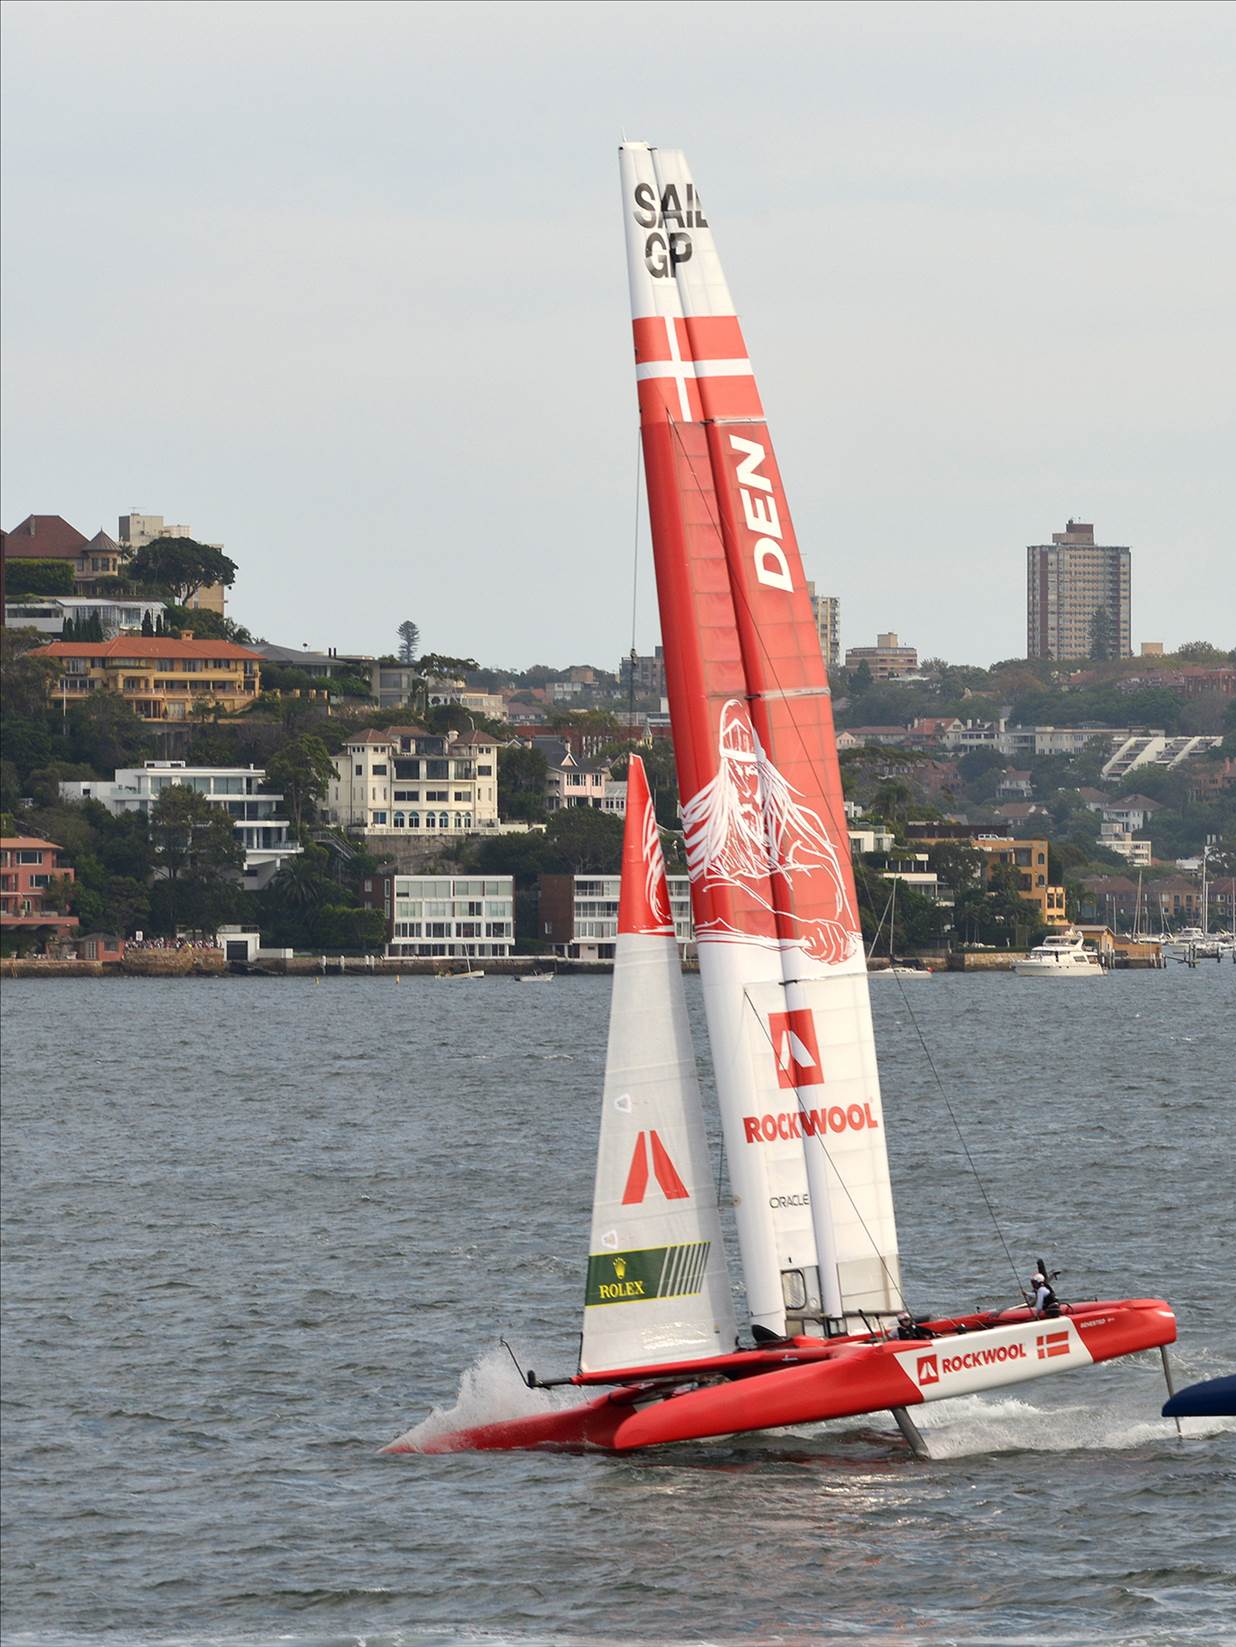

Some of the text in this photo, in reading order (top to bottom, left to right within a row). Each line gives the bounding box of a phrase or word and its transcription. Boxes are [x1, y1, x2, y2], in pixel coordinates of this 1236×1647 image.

[633, 183, 709, 229] SAIL
[644, 232, 693, 279] GP
[729, 434, 794, 593] DEN
[743, 1103, 878, 1143] ROCKWOOL
[769, 1194, 810, 1208] ORACLE
[600, 1280, 645, 1299] ROLEX
[942, 1343, 1026, 1374] ROCKWOOL
